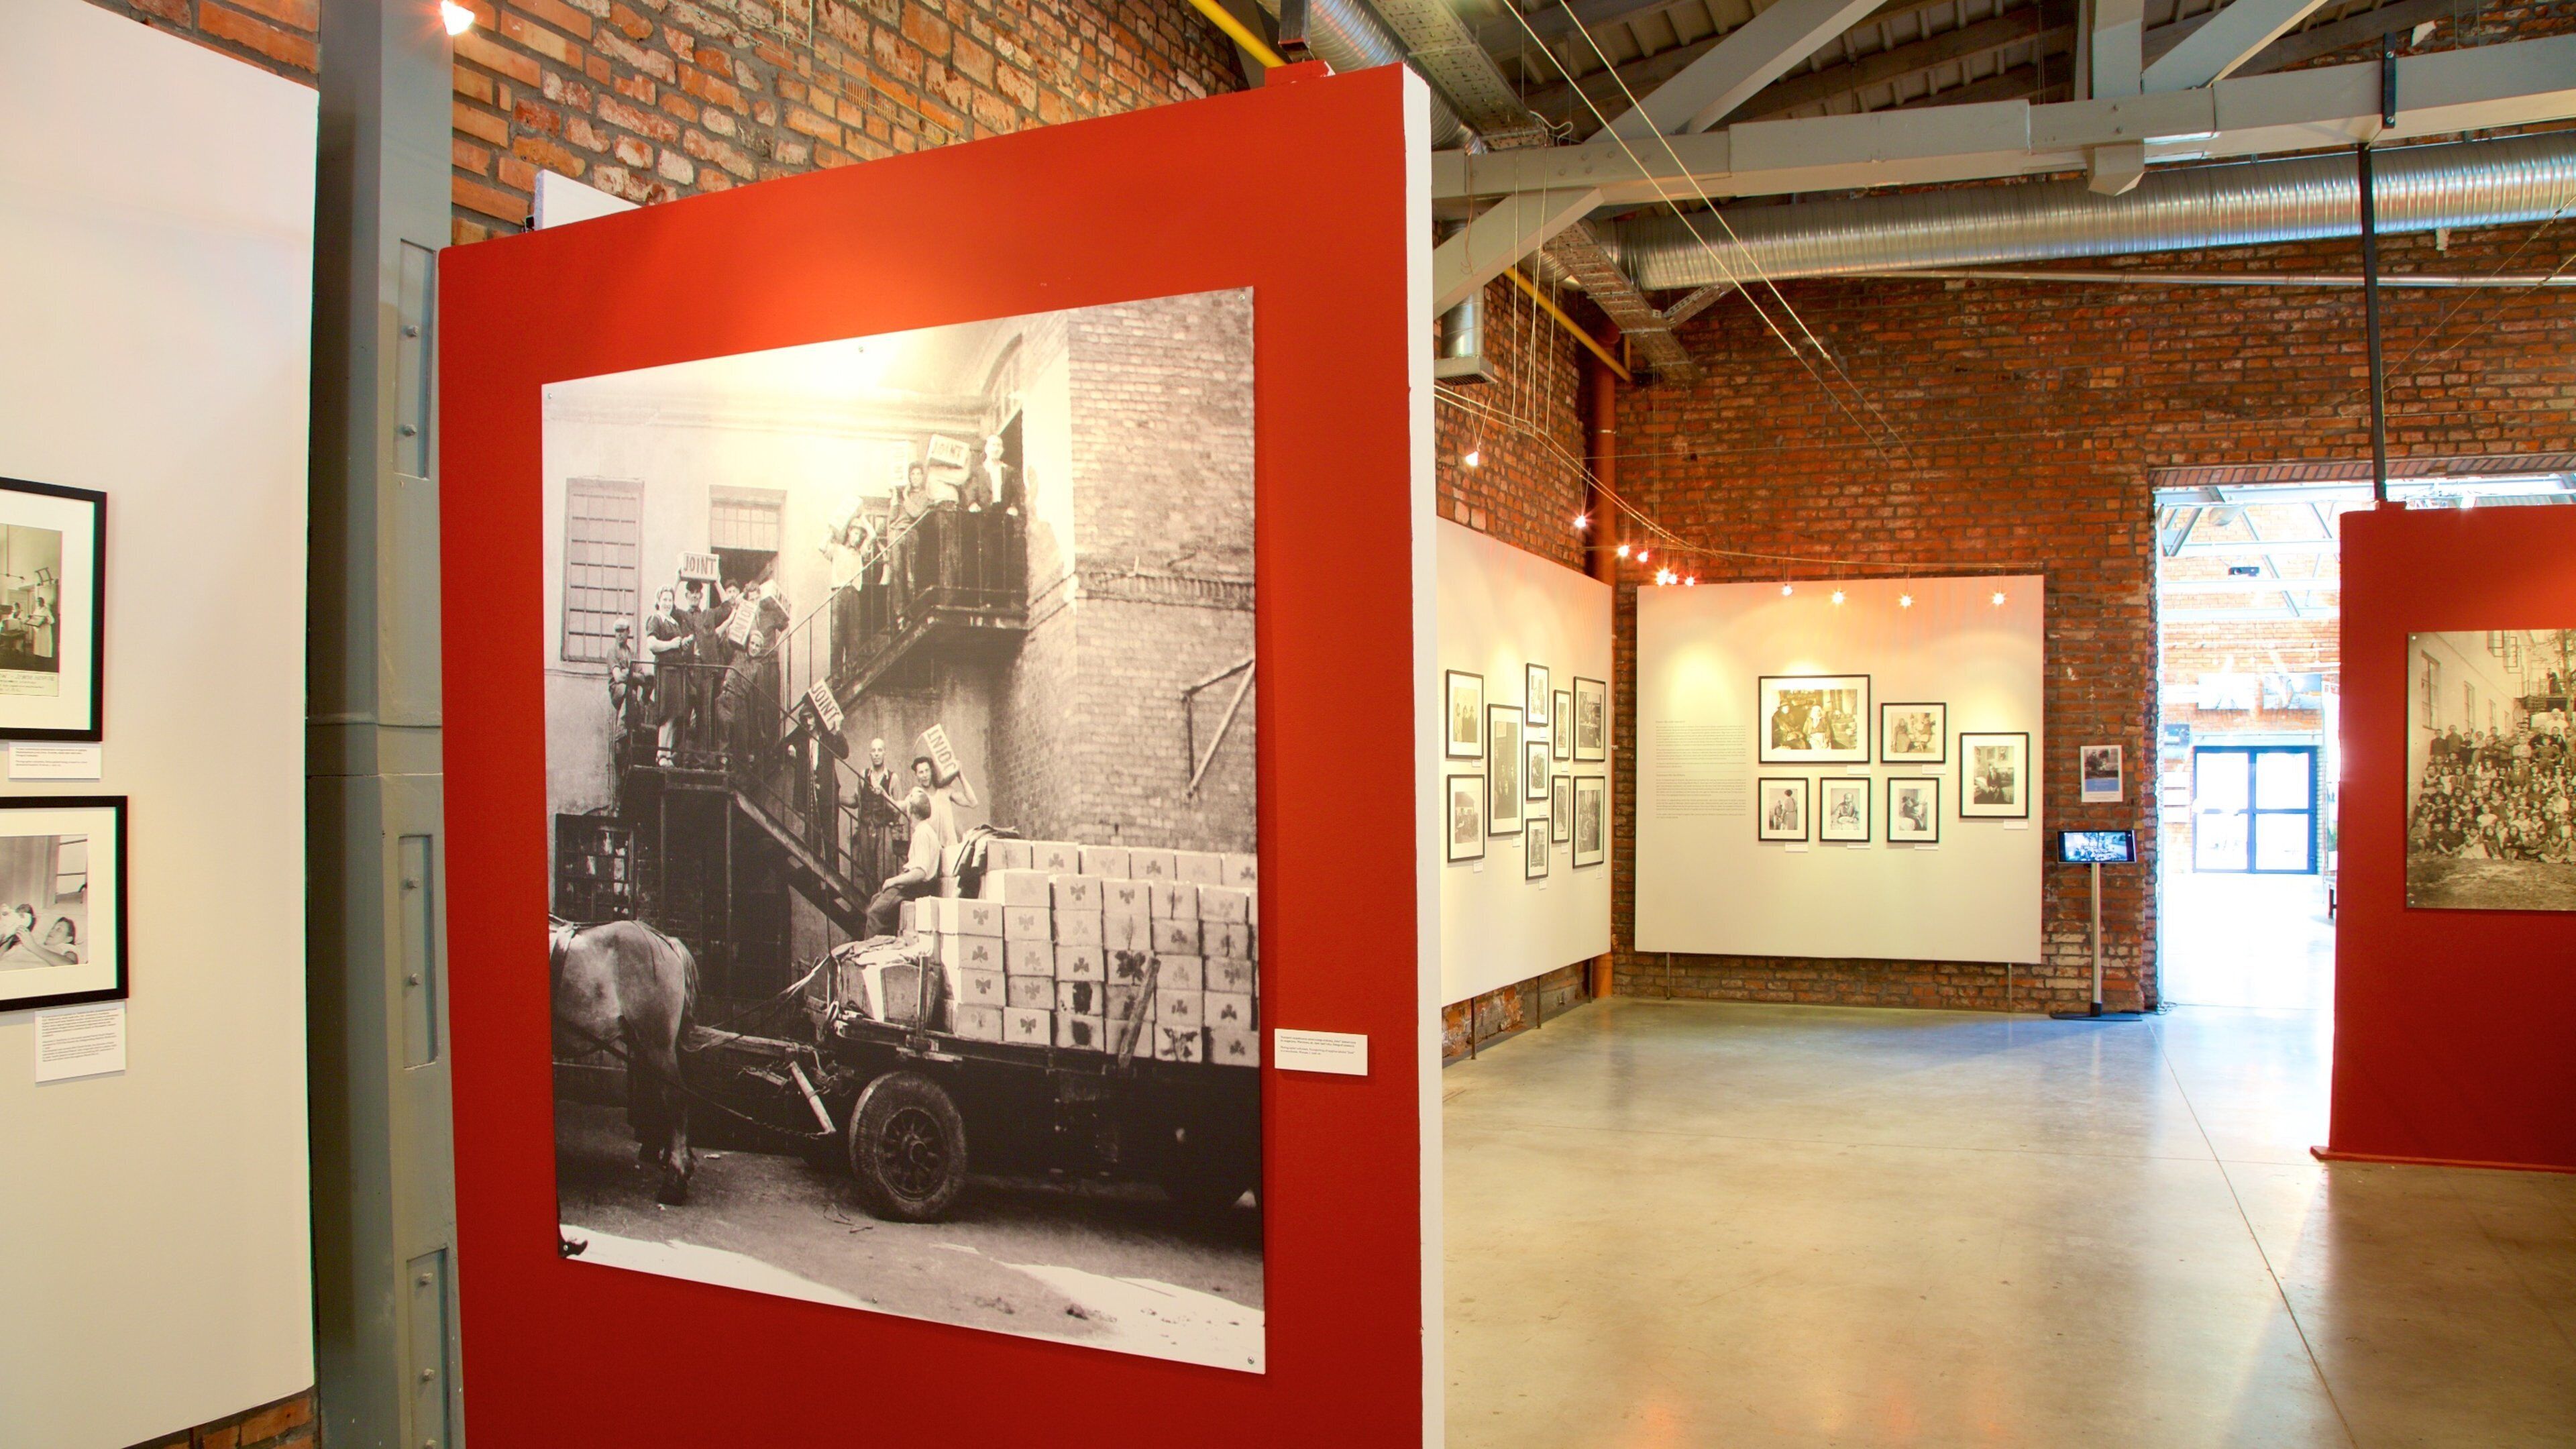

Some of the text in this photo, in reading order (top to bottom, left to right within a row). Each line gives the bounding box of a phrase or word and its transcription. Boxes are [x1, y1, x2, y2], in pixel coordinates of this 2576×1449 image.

[684, 555, 716, 575] JOINT
[732, 602, 755, 642] JOINT
[811, 685, 840, 722] JOINT
[927, 729, 956, 771] JOINT
